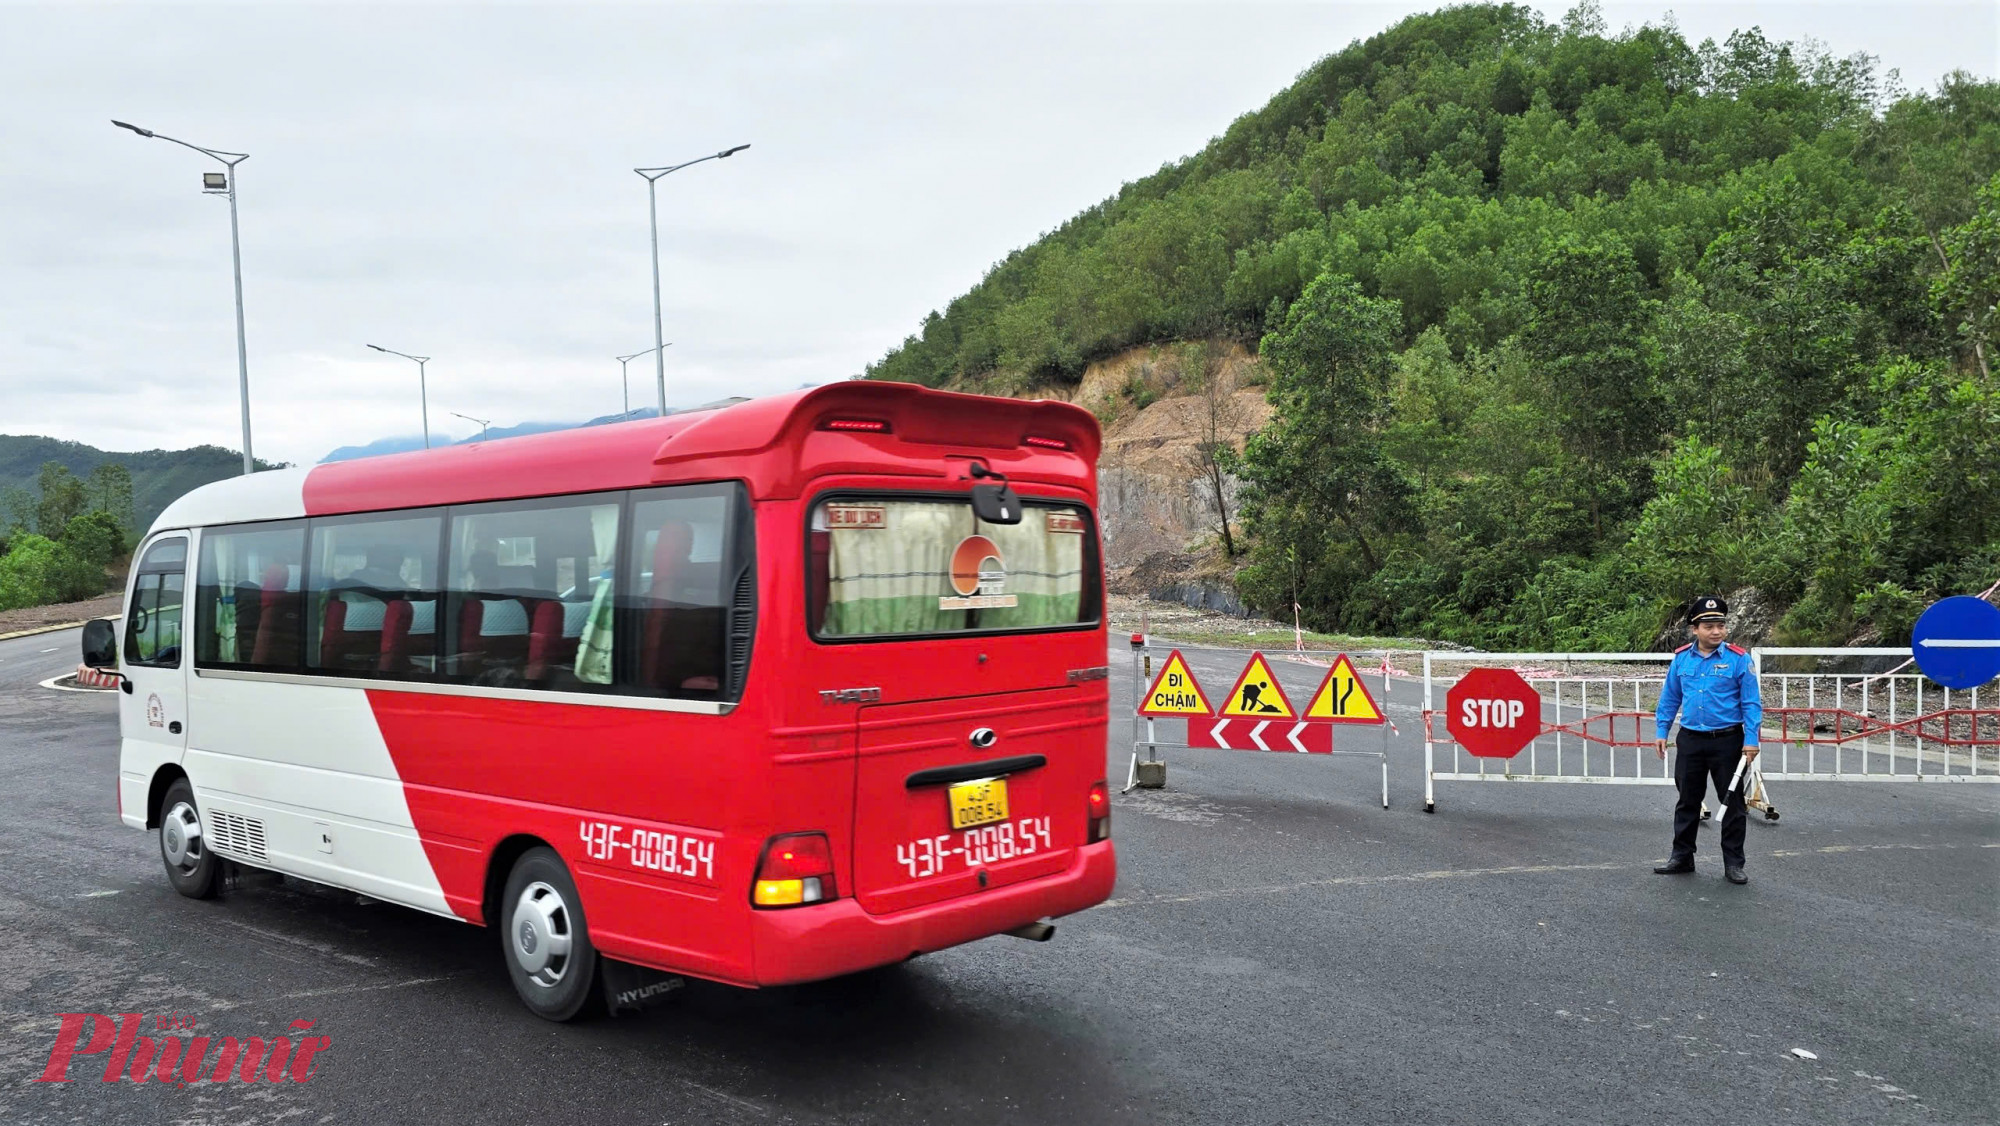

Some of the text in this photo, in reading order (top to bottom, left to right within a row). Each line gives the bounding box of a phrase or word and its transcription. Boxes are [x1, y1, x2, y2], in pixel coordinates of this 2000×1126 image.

[1168, 673, 1183, 687] ĐI
[1154, 690, 1197, 711] CHẬM
[1461, 698, 1525, 729] STOP
[968, 784, 991, 802] 43F
[959, 801, 1003, 825] 008.54
[579, 820, 715, 879] 43F-008.54
[896, 816, 1051, 879] 43F-008.54
[616, 977, 686, 1005] HYUNDAI
